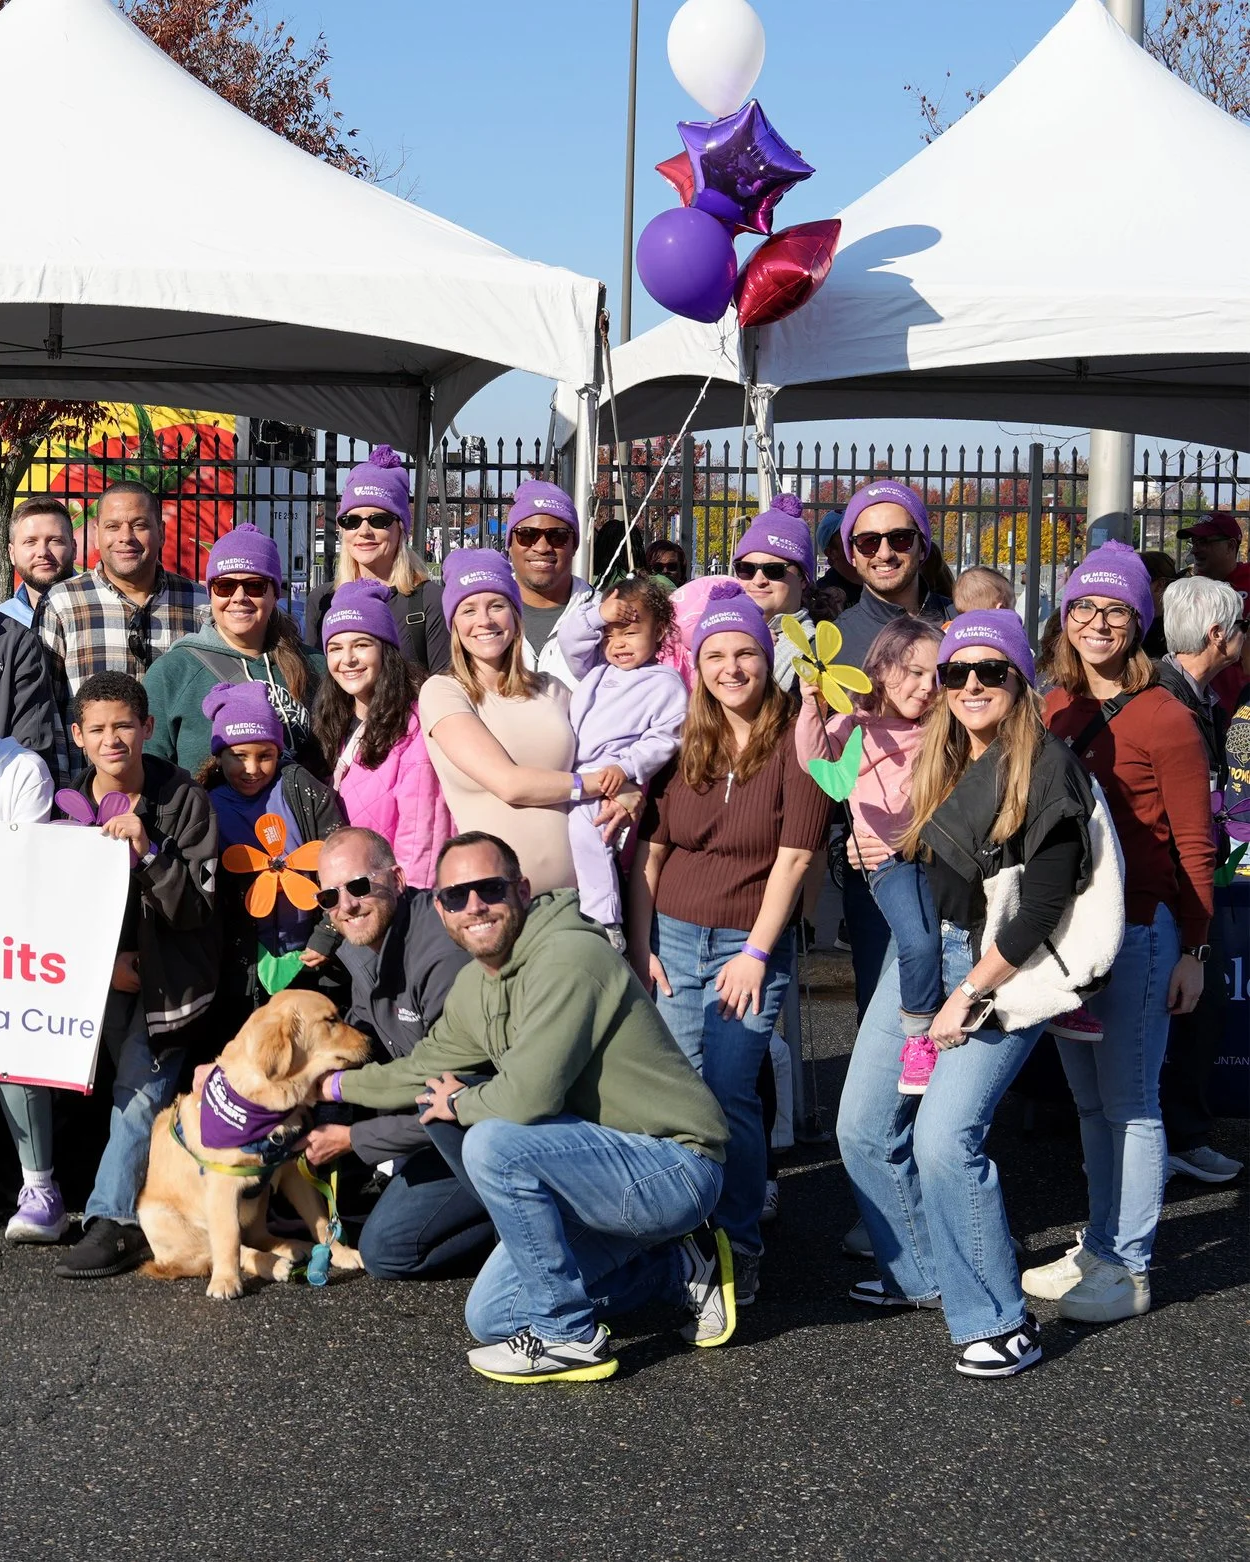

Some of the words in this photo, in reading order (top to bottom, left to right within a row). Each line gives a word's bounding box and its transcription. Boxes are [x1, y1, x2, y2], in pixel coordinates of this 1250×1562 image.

[224, 557, 253, 565] MEDICAL
[222, 563, 255, 571] GUARDIAN
[1091, 571, 1126, 581] MEDICAL
[1089, 577, 1128, 587] GUARDIAN
[332, 609, 361, 618] MEDICAL
[709, 611, 740, 620] MEDICAL
[330, 615, 363, 624] GUARDIAN
[707, 616, 743, 626] GUARDIAN
[231, 728, 267, 736] GUARDIAN
[21, 1008, 94, 1040] Cure
